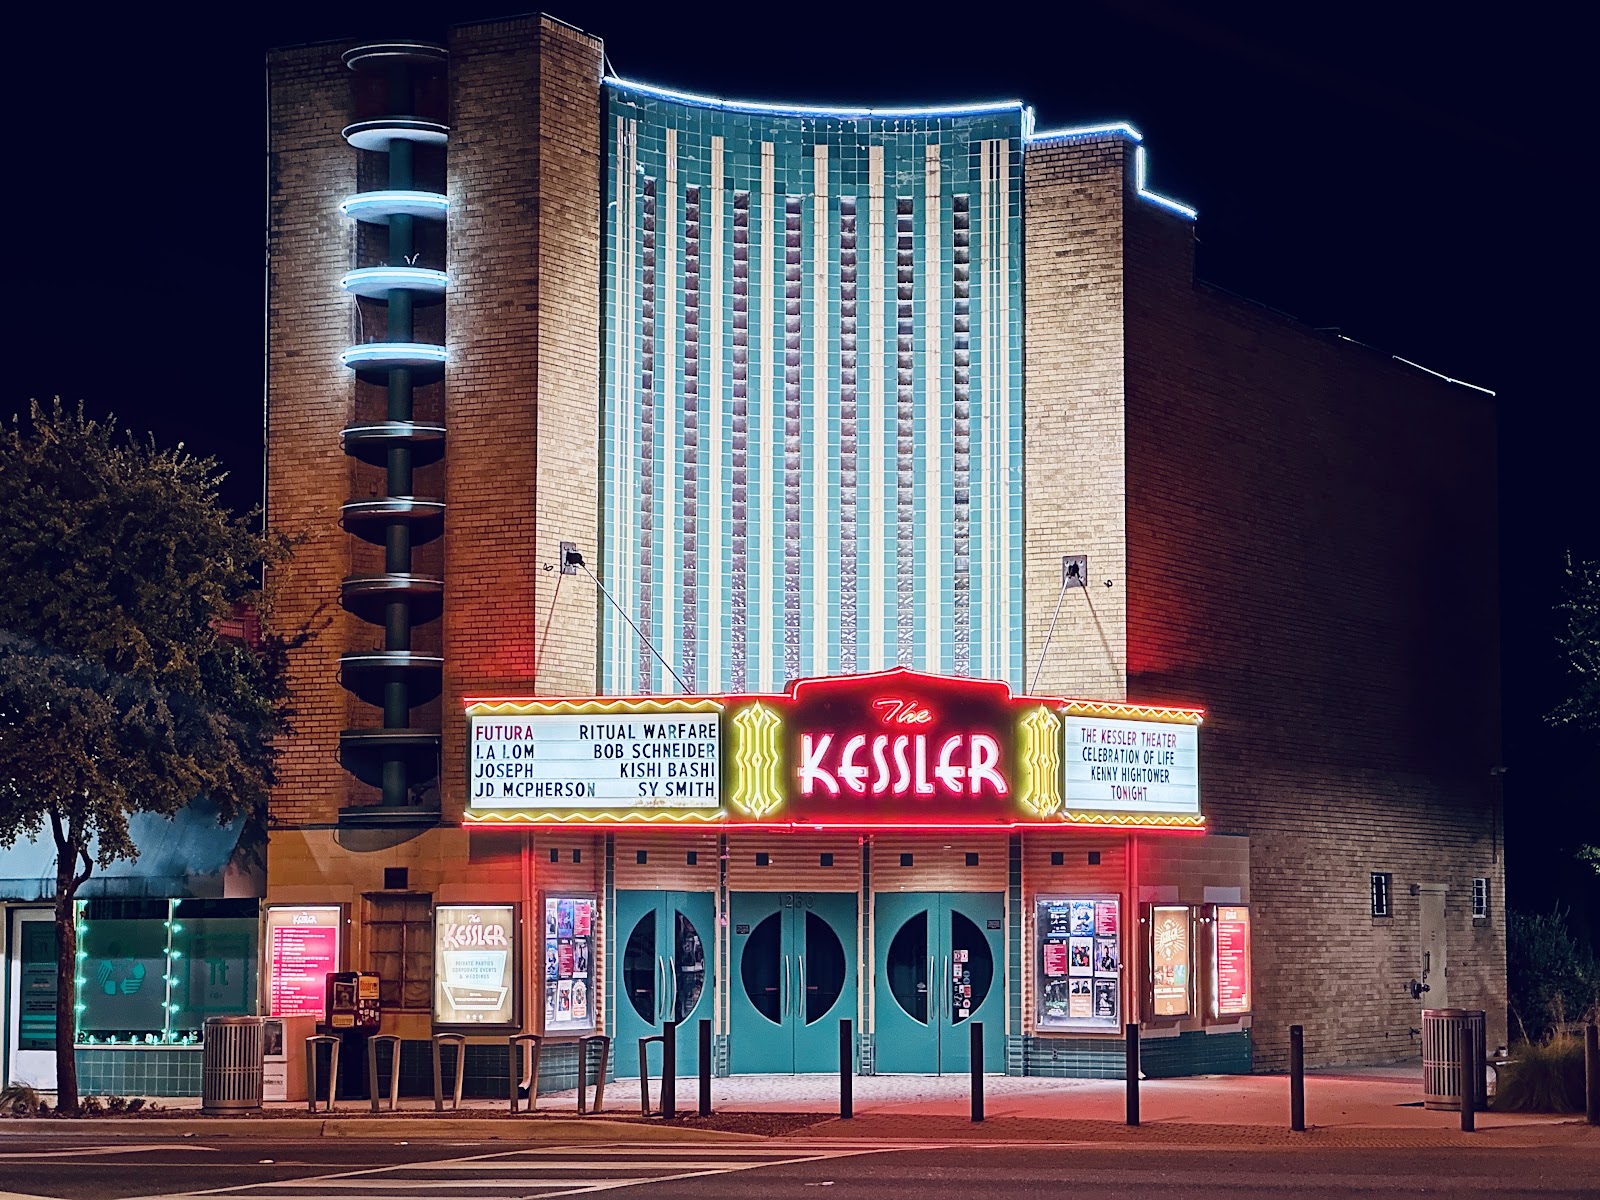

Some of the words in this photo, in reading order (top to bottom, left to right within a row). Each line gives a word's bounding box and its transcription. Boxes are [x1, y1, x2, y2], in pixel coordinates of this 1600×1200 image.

[872, 697, 933, 724] The
[475, 725, 534, 741] FUTURA
[579, 724, 636, 740] RITUAL
[643, 723, 716, 739] WARFARE
[1081, 727, 1097, 743] THE
[1101, 729, 1137, 746] KESSLER
[1141, 732, 1177, 748] THEATER
[475, 744, 495, 760] LA
[502, 744, 535, 760] LOM
[594, 743, 624, 759] BOB
[632, 742, 715, 759] SCHNEIDER
[1082, 747, 1140, 764] CELEBRATION
[1143, 750, 1155, 765] OF
[1157, 751, 1175, 766] LIFE
[474, 763, 534, 778] JOSEPH
[620, 762, 661, 778] KISHI
[668, 762, 715, 778] BASHI
[797, 733, 1009, 795] KESSLER
[1091, 765, 1118, 782] KENNY
[1121, 767, 1170, 784] HIGHTOWER
[474, 782, 494, 797] JD
[503, 782, 596, 798] MCPHERSON
[638, 782, 659, 797] SY
[665, 781, 715, 797] SMITH
[1110, 785, 1148, 801] TONIGHT
[443, 923, 508, 949] KESSLER
